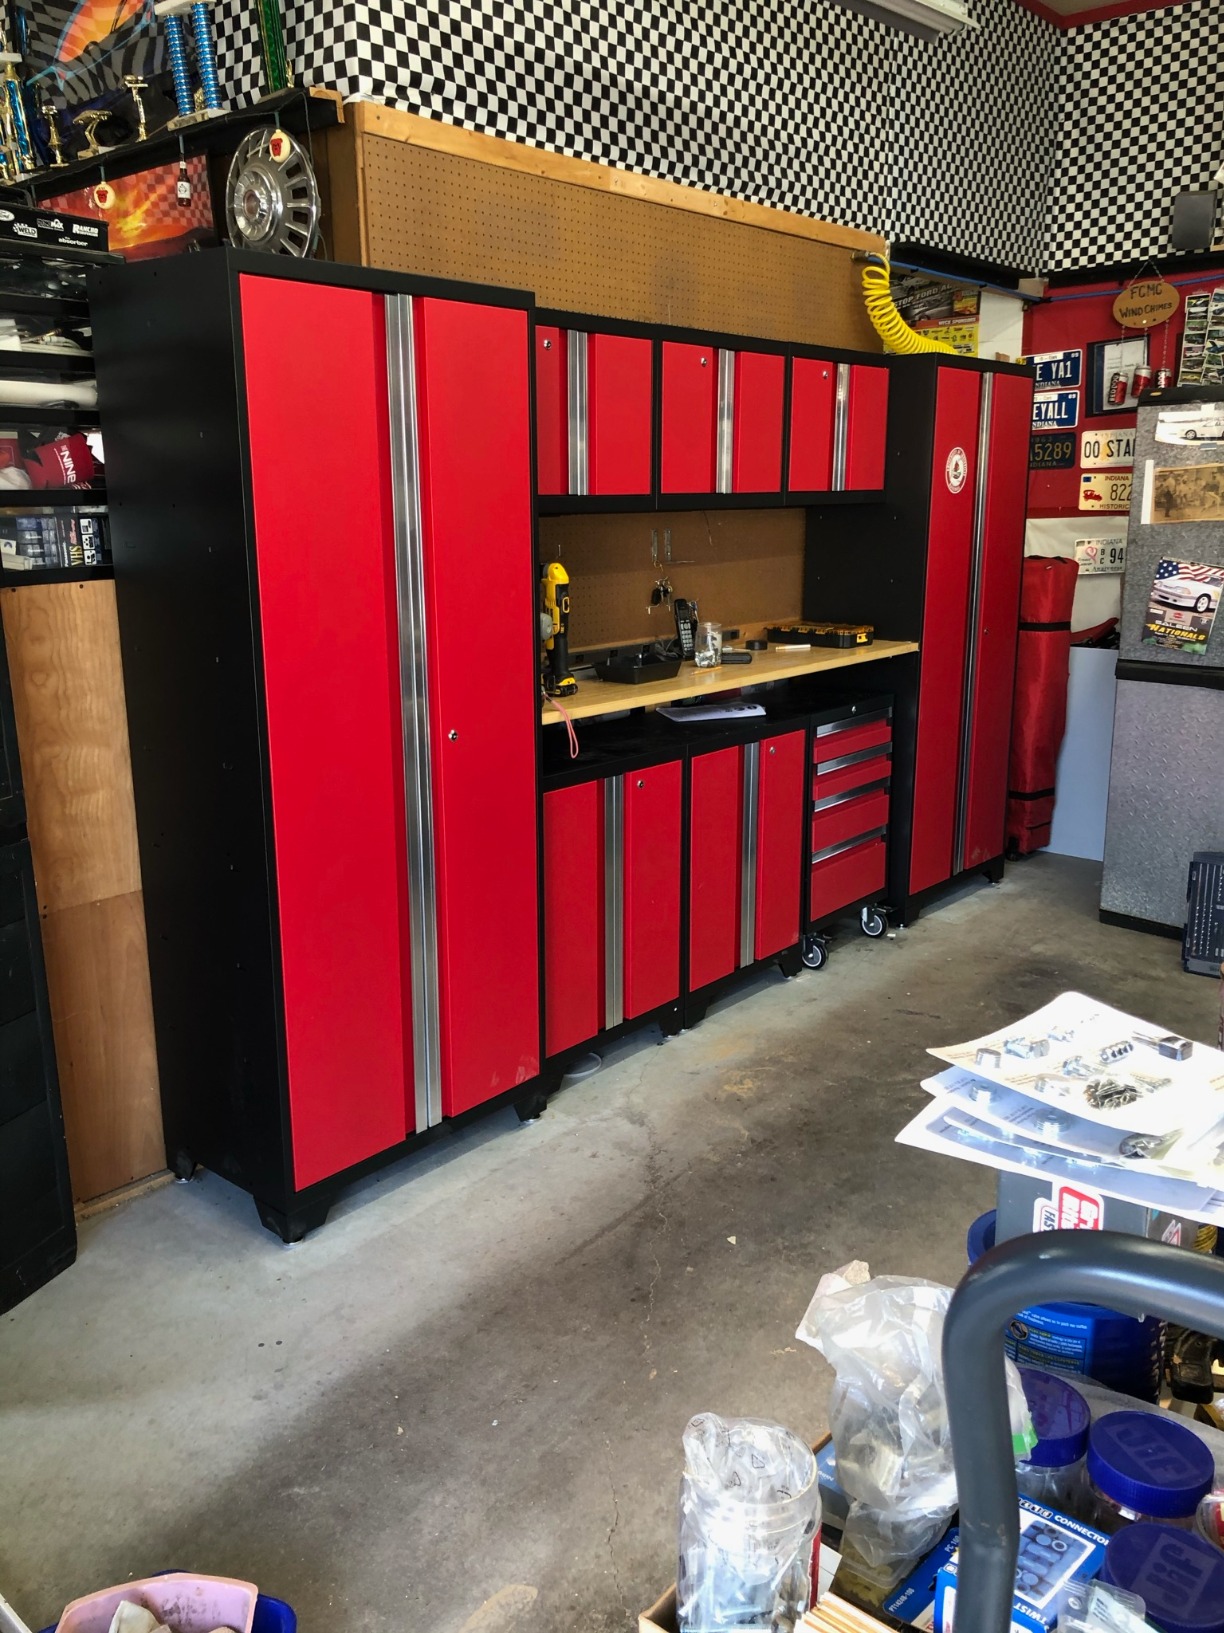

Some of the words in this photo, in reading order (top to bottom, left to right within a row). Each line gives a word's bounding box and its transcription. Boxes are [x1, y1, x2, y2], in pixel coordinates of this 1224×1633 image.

[1119, 306, 1144, 318] WIND
[1144, 302, 1173, 315] CHIMES
[1034, 379, 1061, 389] NDIANA
[1031, 420, 1058, 429] NDIANA
[69, 545, 83, 566] VHS
[1109, 547, 1125, 565] 94
[1149, 624, 1206, 641] NATIONALS
[1155, 620, 1198, 632] SALEEN
[1043, 1209, 1056, 1231] FAS
[1013, 1602, 1048, 1625] TWIST
